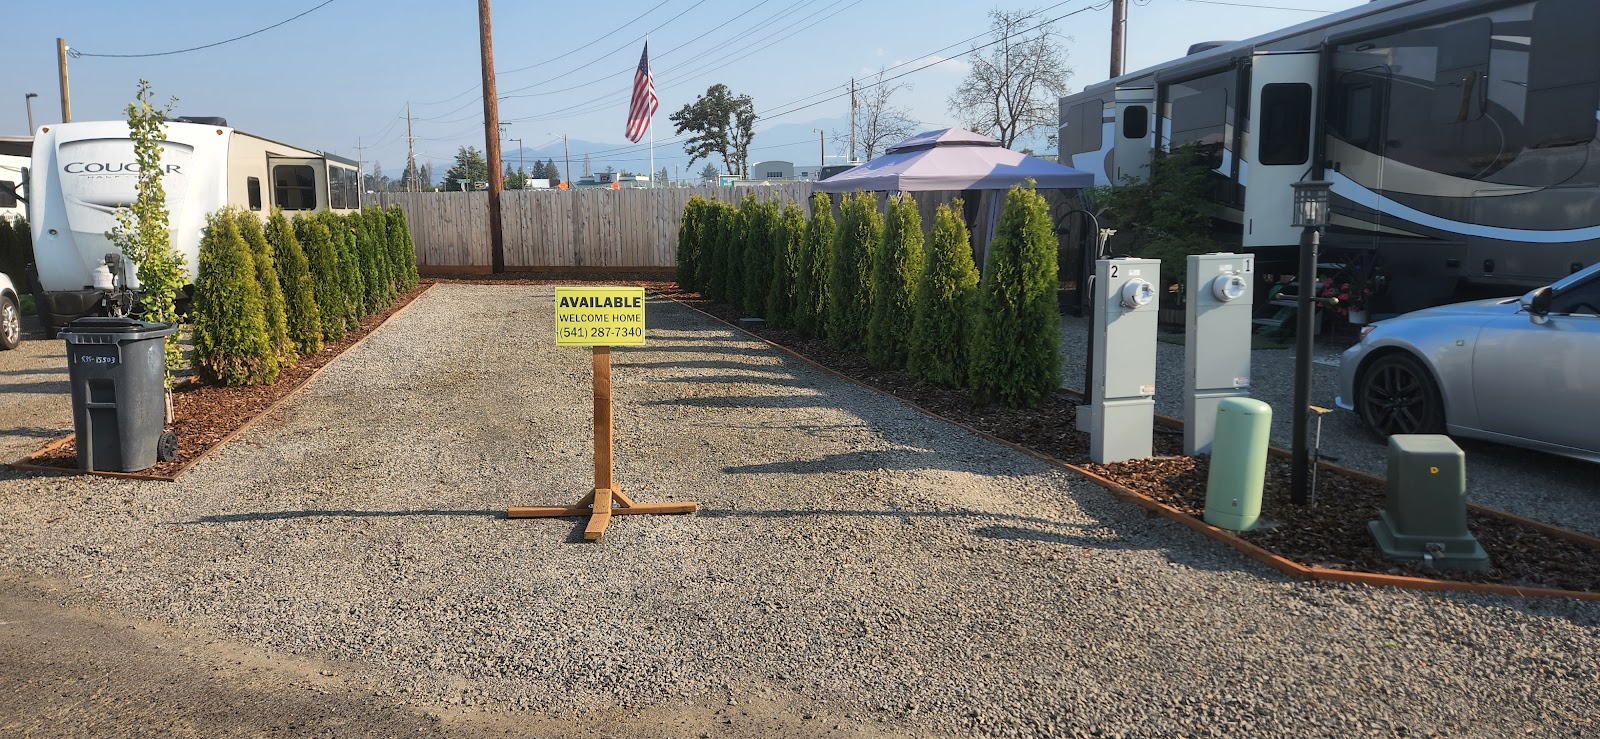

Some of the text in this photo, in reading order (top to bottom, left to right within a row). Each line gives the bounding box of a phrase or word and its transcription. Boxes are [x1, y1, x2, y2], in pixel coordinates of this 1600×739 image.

[64, 162, 182, 174] COUGR
[1111, 265, 1118, 278] 2
[1245, 259, 1251, 272] 1
[560, 296, 641, 308] AVAILABLE
[559, 314, 641, 322] WELCOME HOME
[559, 327, 642, 339] (541) 287-7340
